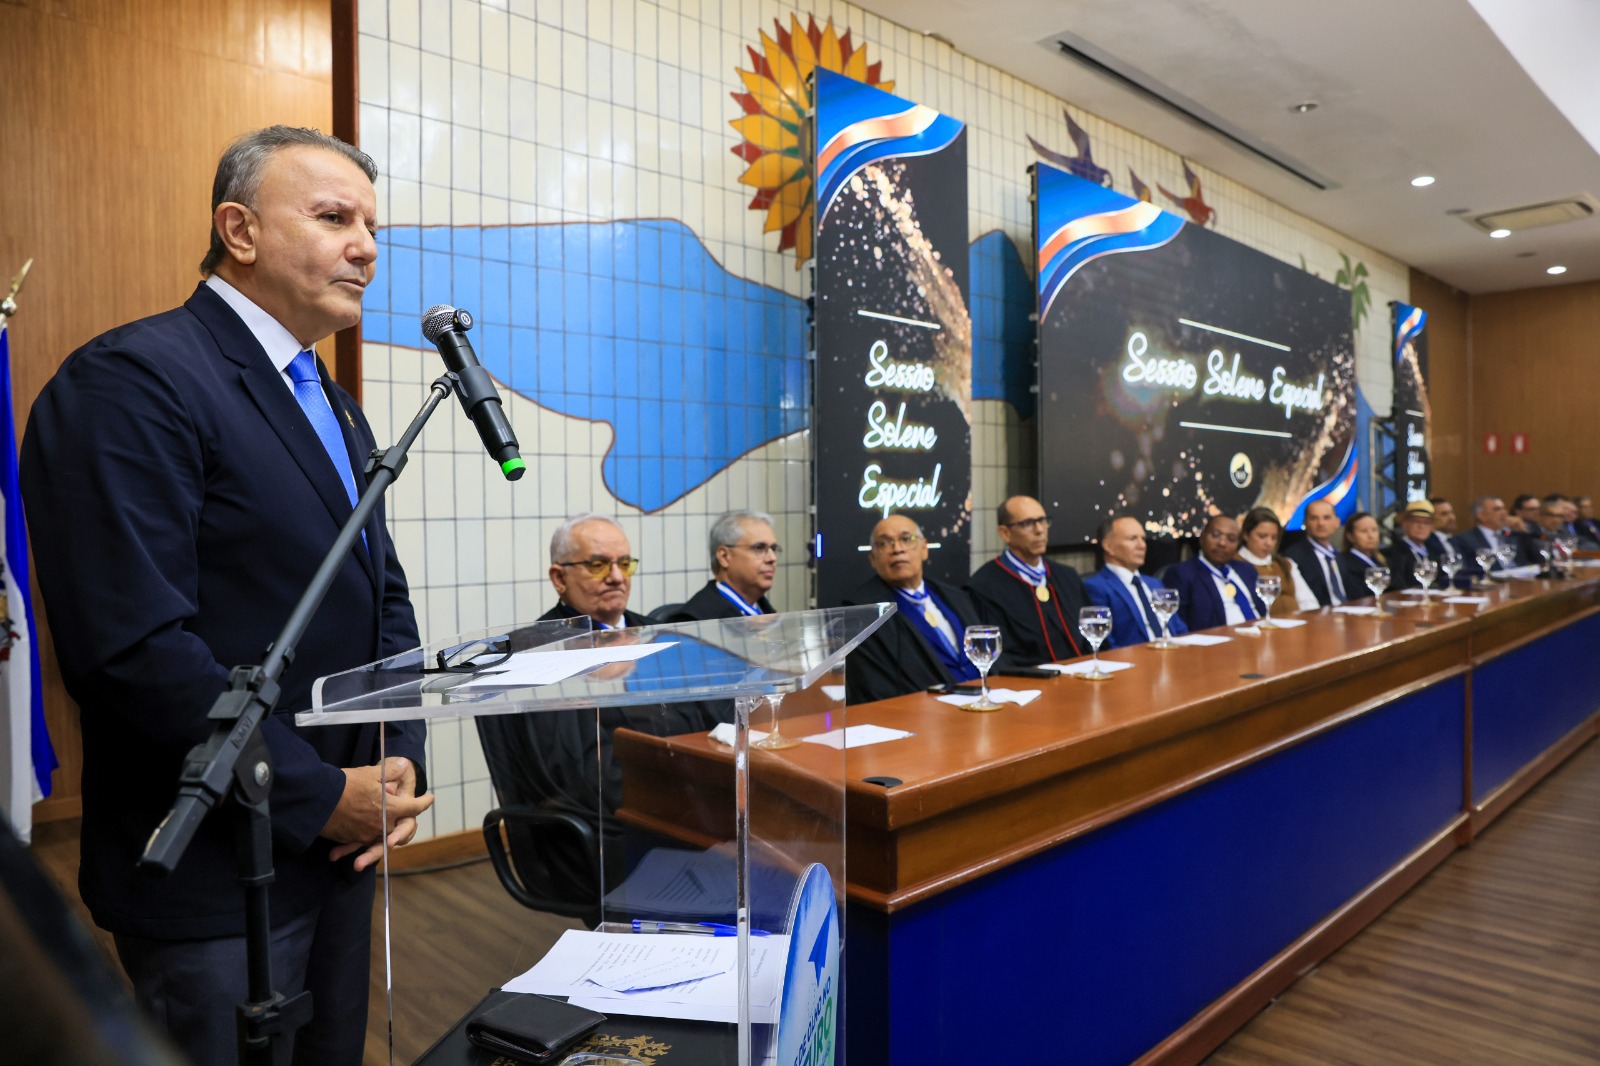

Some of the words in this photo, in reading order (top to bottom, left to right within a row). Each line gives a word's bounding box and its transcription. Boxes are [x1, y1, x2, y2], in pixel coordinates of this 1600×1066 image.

[865, 339, 935, 392] Sessão
[1122, 331, 1198, 390] Sessão
[1203, 348, 1266, 400] Solene
[1269, 366, 1326, 420] Especial
[863, 401, 938, 450] Solene
[858, 463, 942, 519] Especial
